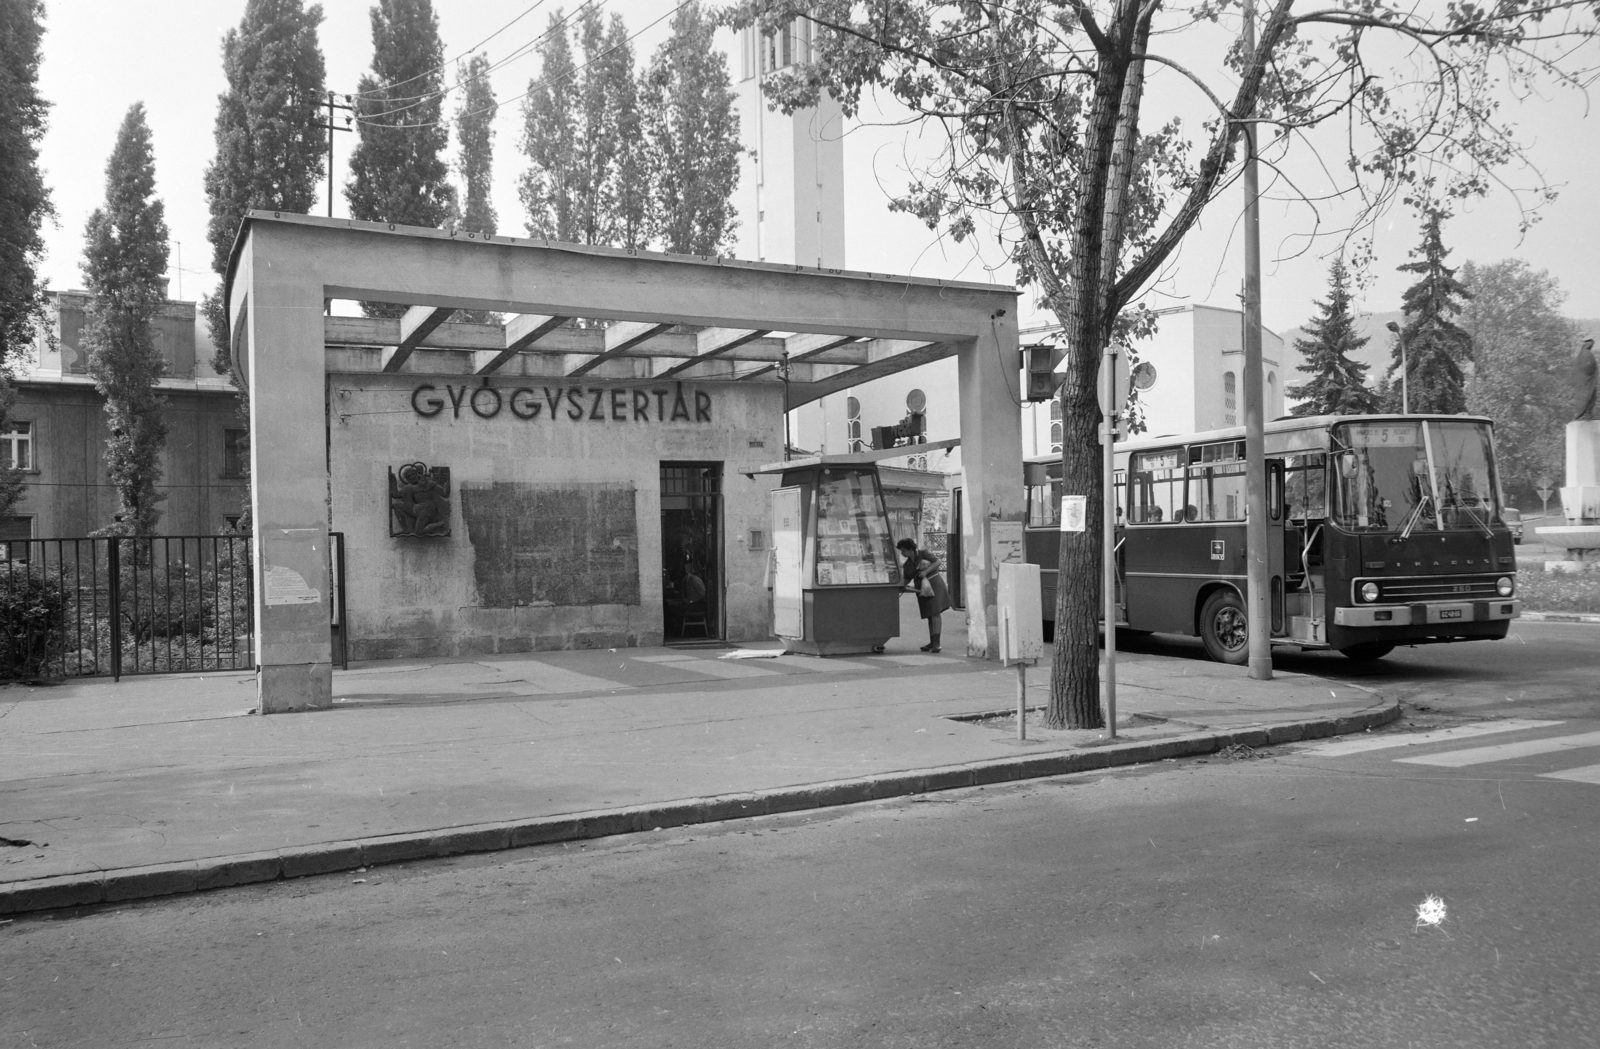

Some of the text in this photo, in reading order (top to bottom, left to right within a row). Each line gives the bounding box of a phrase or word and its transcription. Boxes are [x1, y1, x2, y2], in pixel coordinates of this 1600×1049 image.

[410, 376, 712, 422] GYÓGYSZERTÁR
[1381, 429, 1389, 443] 5
[1159, 455, 1165, 467] 5
[1396, 558, 1490, 567] IKARUS
